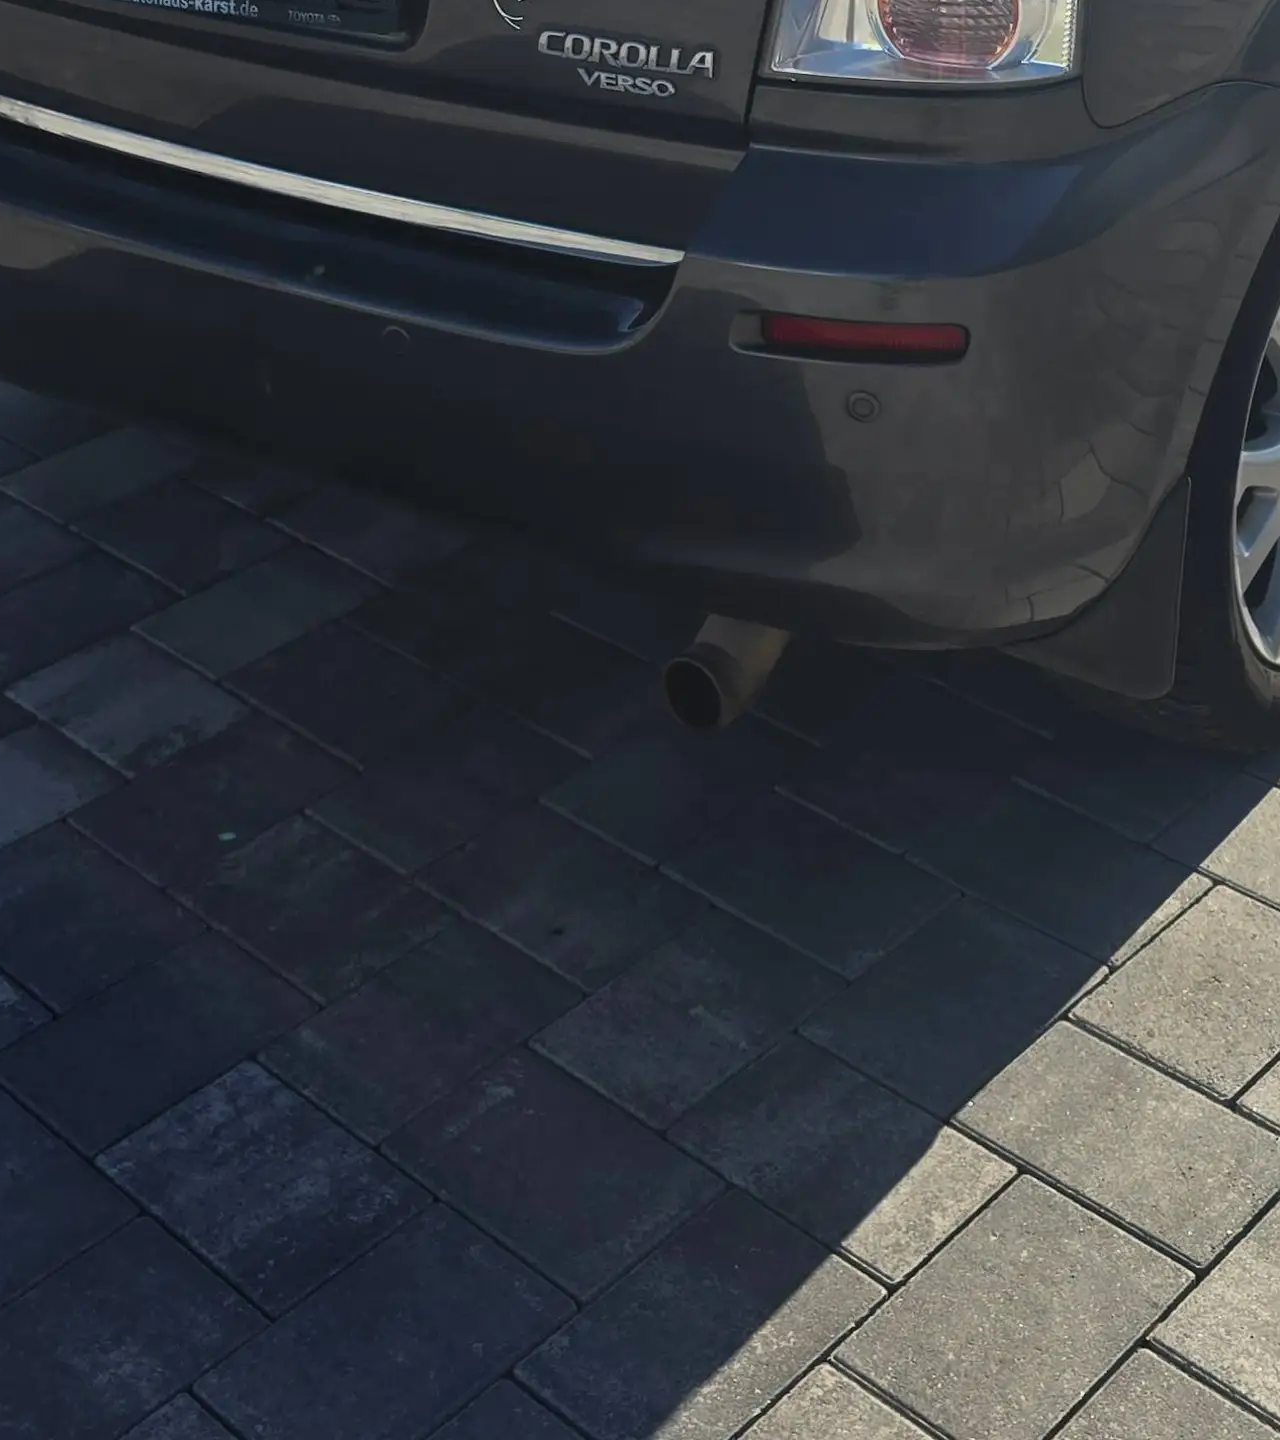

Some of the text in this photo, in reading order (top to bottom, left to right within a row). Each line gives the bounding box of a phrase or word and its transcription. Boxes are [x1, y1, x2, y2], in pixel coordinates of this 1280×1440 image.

[288, 9, 325, 25] TOYOTA
[538, 30, 715, 79] COROLLA
[577, 67, 676, 97] VERSO
